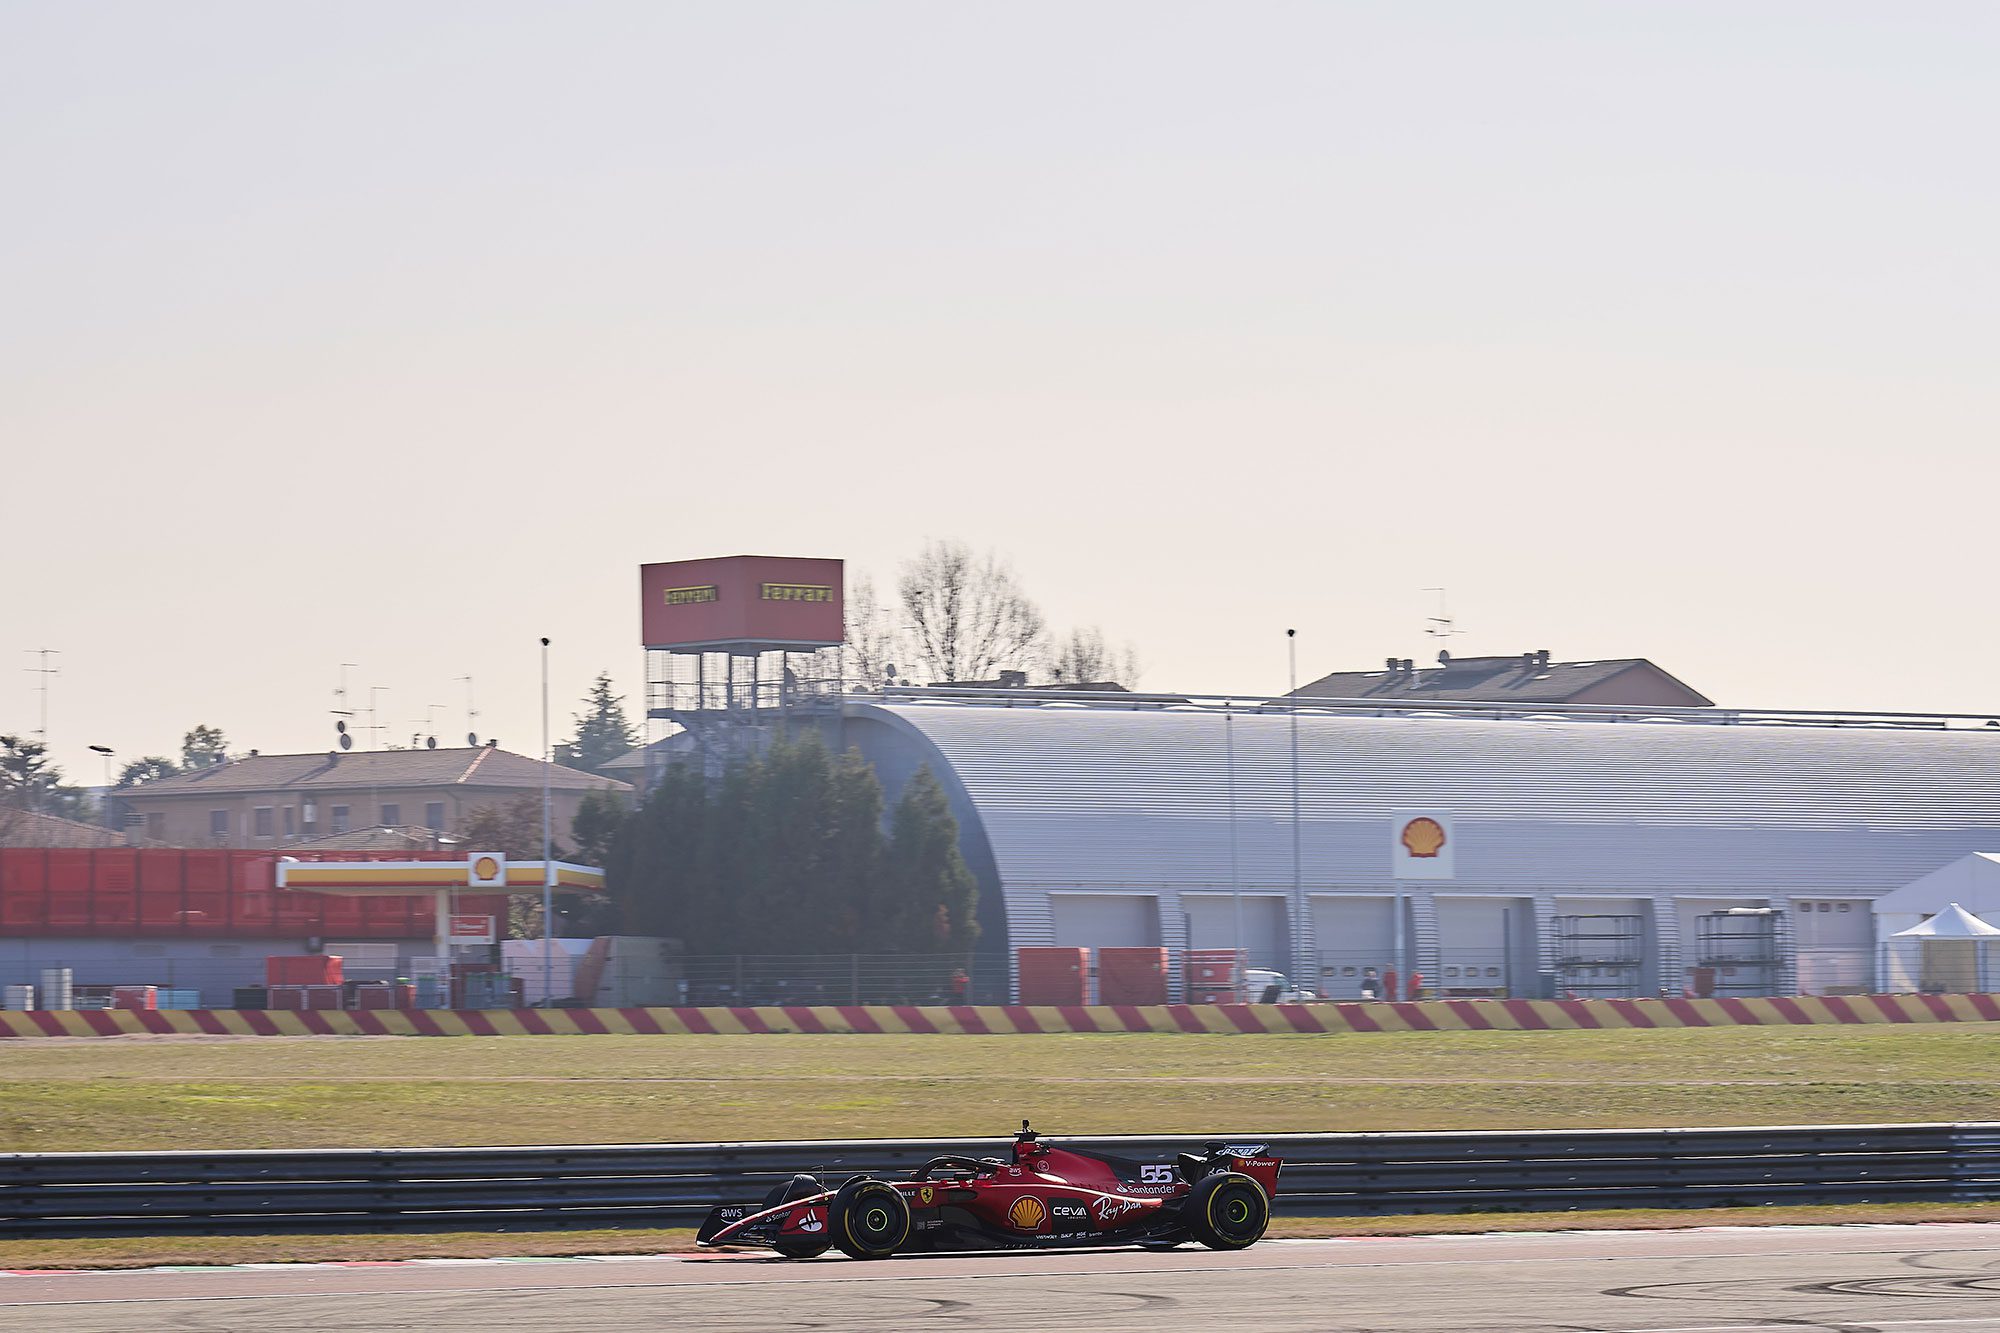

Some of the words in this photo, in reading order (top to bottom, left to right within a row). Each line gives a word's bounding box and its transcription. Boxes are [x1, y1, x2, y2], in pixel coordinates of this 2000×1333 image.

[761, 582, 833, 602] Ferrari
[1140, 1165, 1173, 1184] 55
[1127, 1185, 1176, 1194] Santander
[720, 1208, 743, 1218] aws
